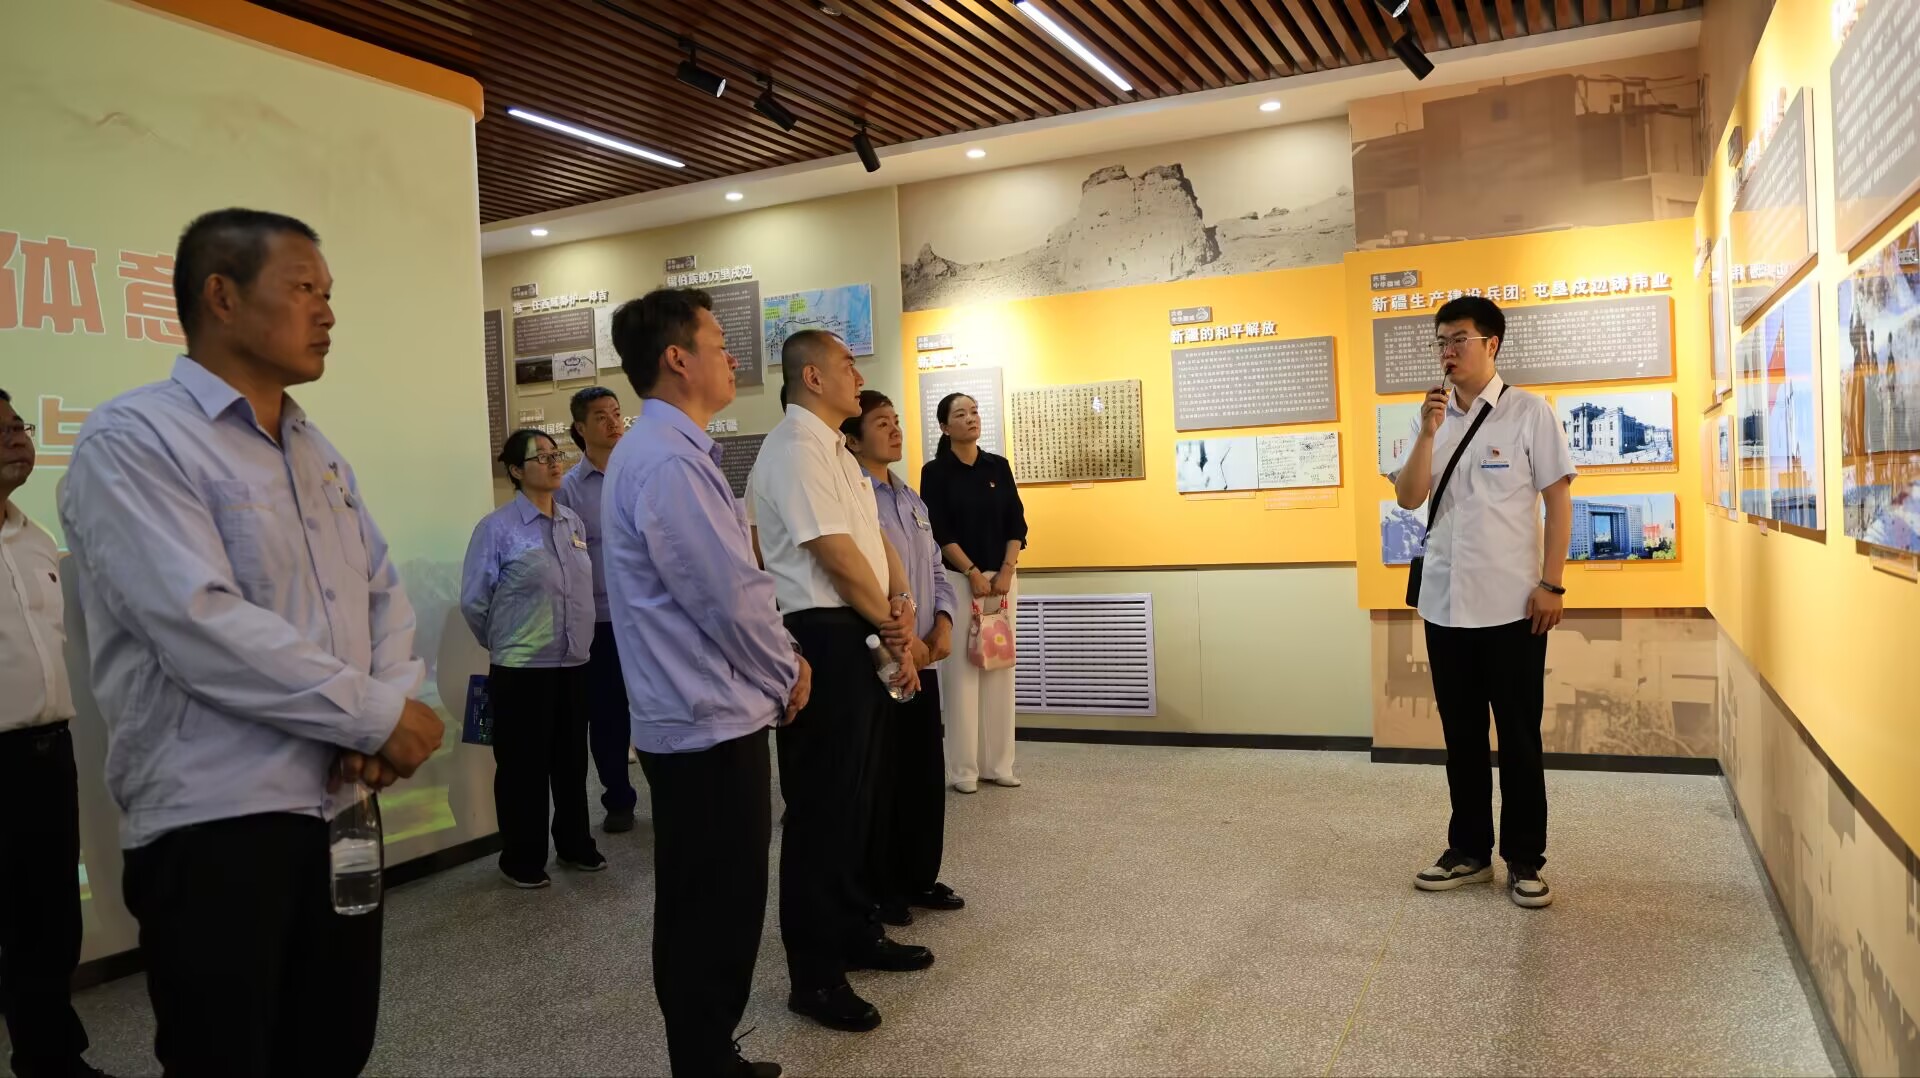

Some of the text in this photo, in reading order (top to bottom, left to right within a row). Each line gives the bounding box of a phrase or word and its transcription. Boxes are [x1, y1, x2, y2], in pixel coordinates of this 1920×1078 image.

[666, 263, 753, 288] 锡伯族的万里戍边
[1170, 321, 1277, 344] 新疆的和平解放
